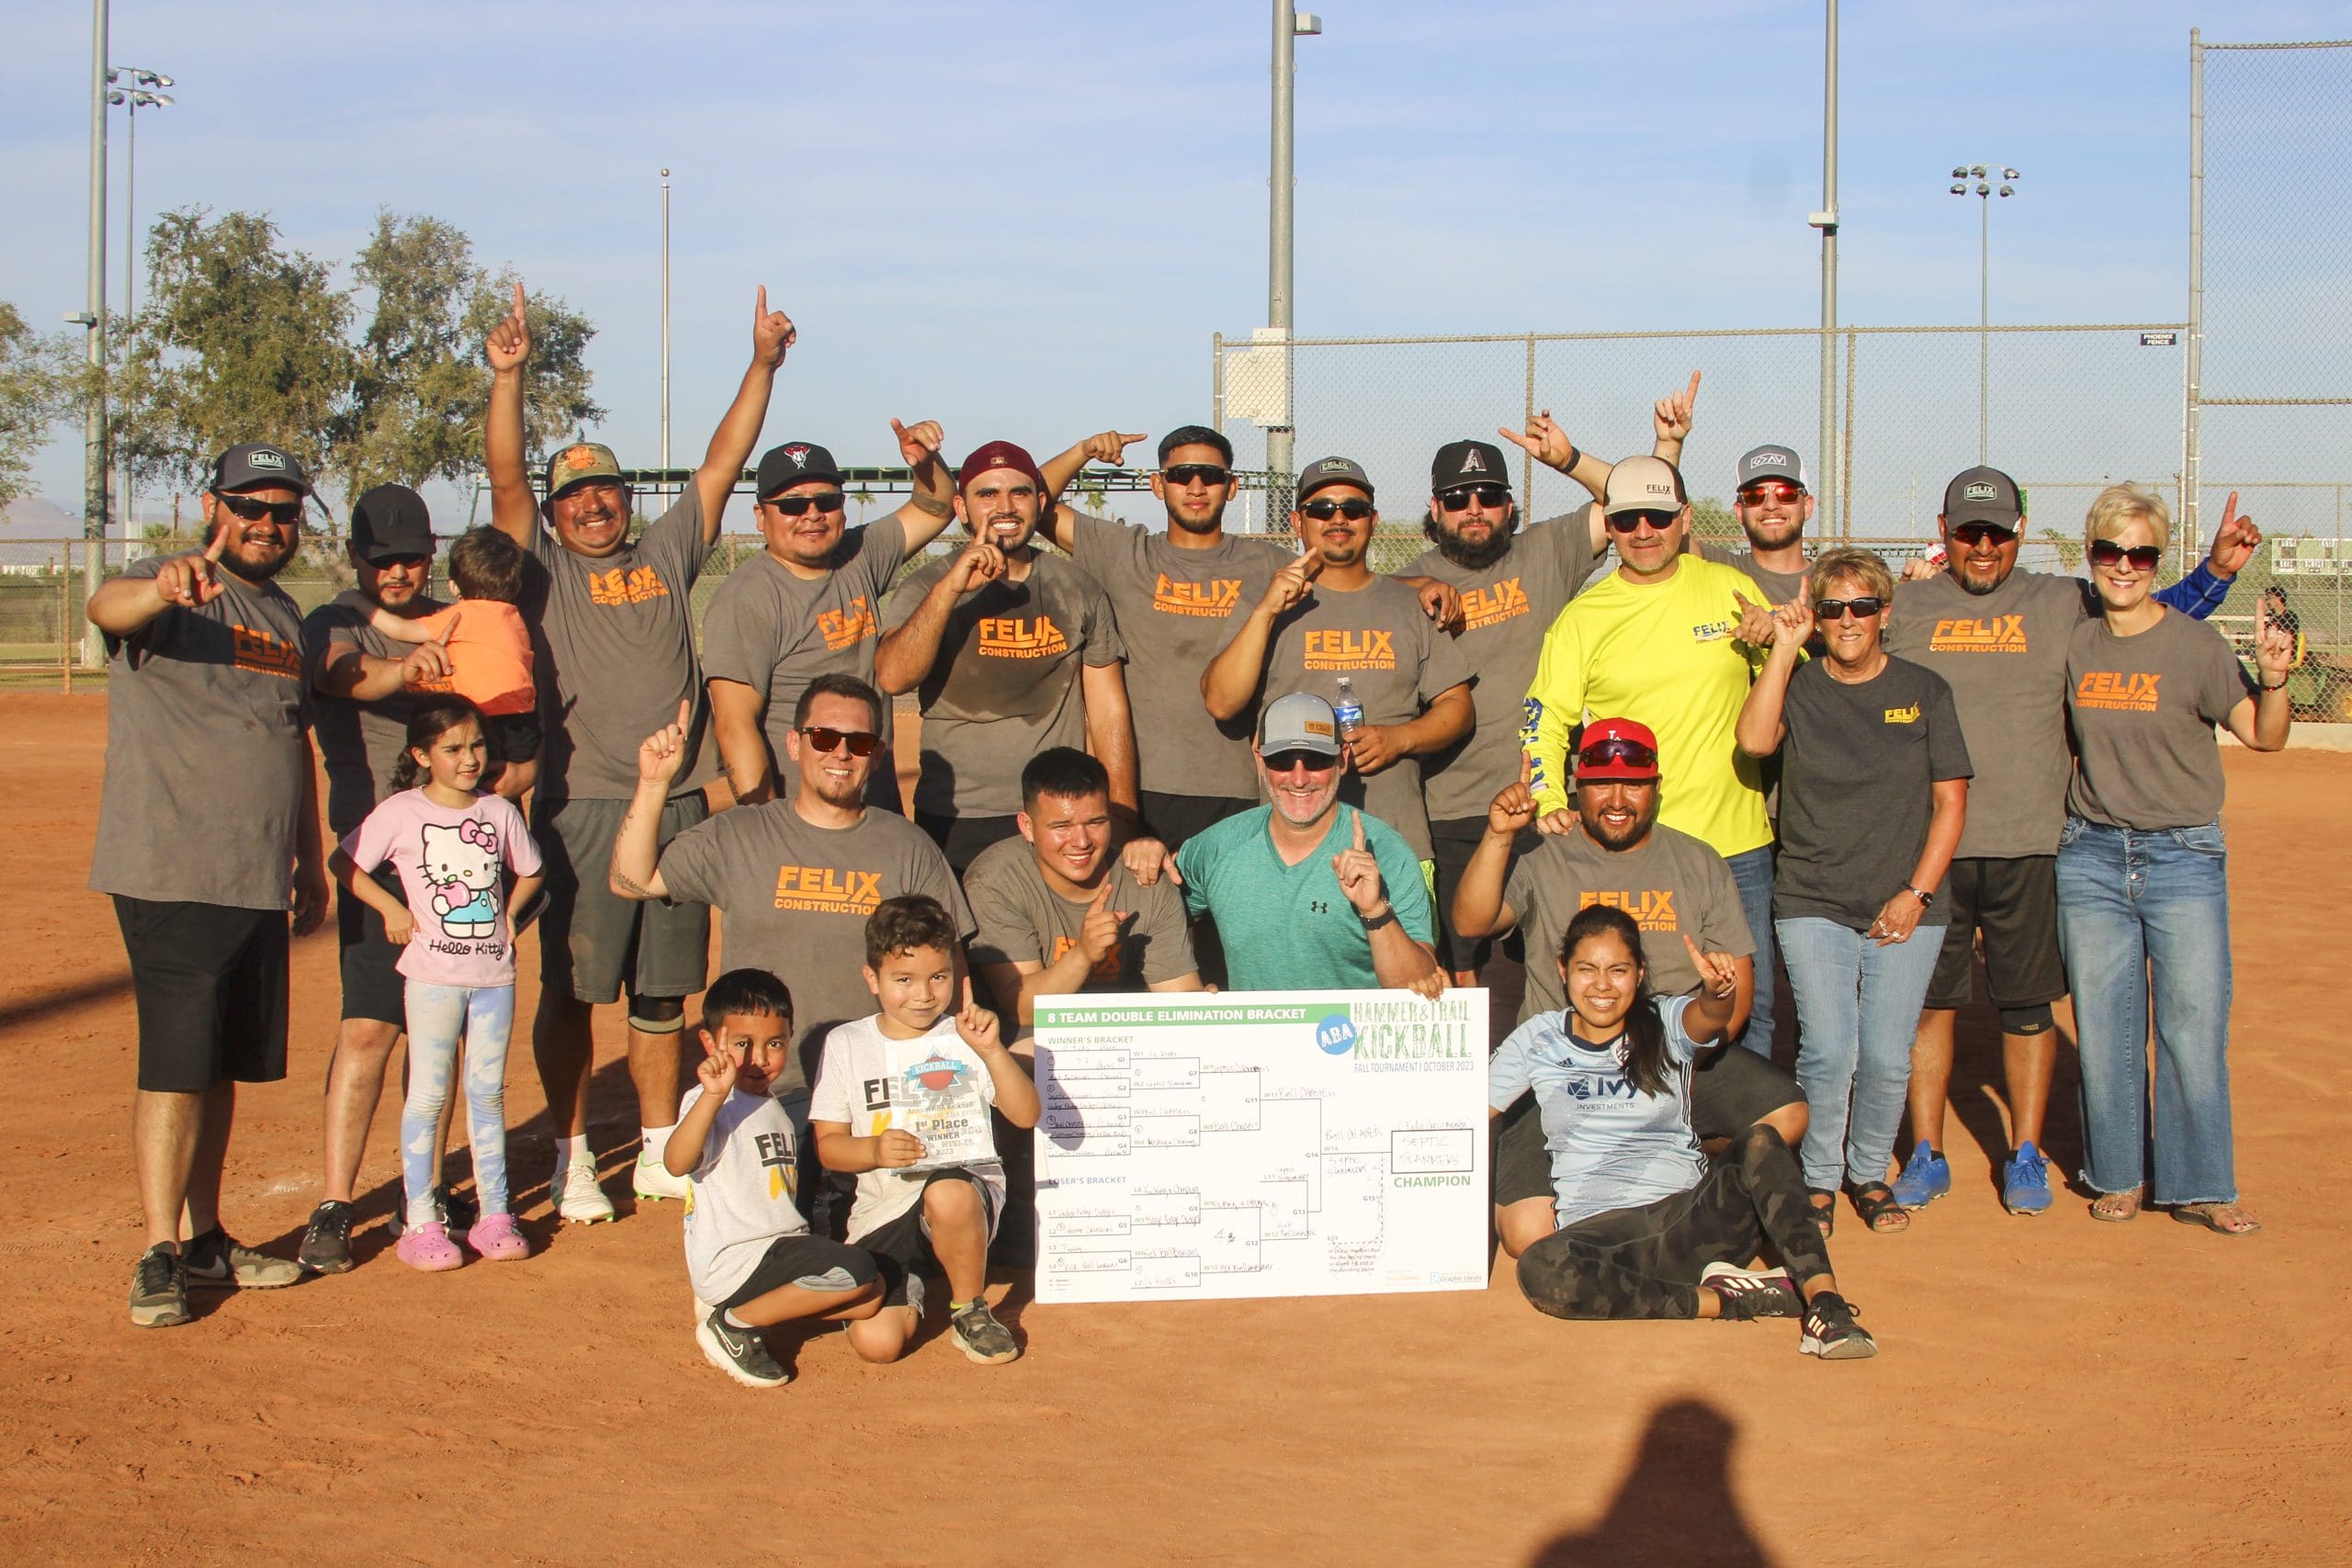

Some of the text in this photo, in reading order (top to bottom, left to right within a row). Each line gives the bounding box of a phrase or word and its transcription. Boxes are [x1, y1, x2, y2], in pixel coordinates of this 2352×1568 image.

[252, 454, 283, 466] FELIX
[1646, 484, 1671, 494] FELIX
[1967, 486, 1994, 495] FELIX
[1155, 572, 1241, 606] FELIX
[1461, 578, 1527, 612] ELIX
[1154, 602, 1232, 617] CONSTRUCTI
[978, 615, 1065, 648] FELIX
[1932, 615, 2026, 643] FELIX
[978, 641, 1068, 659] CONSTRUCTION
[1305, 630, 1395, 659] FELIX
[1929, 644, 2028, 653] CONSTRUCTION
[1304, 660, 1396, 671] CONSTRUCTION
[2078, 672, 2161, 700] FELIX
[1885, 702, 1920, 720] FELIX
[2075, 699, 2157, 712] CONSTRUCTION
[776, 865, 882, 903] FELIX
[775, 897, 876, 916] CONSTRUCTIO
[1580, 890, 1676, 920] FELIX
[429, 939, 505, 961] Hello Kitty
[1047, 1009, 1306, 1023] 8 TEAM DOUBLE ELIMINATION BRACKET
[1048, 1035, 1134, 1044] WINNER'S BRACKET
[1320, 1023, 1353, 1047] ABA
[1354, 1023, 1472, 1059] KICKBALL
[914, 1061, 957, 1075] KICKBALL
[1354, 1061, 1474, 1073] FALL TOURNAMENT OCTOBER 2023
[1598, 1077, 1639, 1099] Ivy
[1577, 1101, 1635, 1111] INVESTMENTS
[915, 1119, 968, 1132] 1st Place
[926, 1132, 960, 1142] WINNER
[754, 1133, 796, 1159] FELI
[935, 1147, 954, 1156] 2023
[1048, 1177, 1084, 1185] LOSER'S
[1394, 1175, 1471, 1188] CHAMPION
